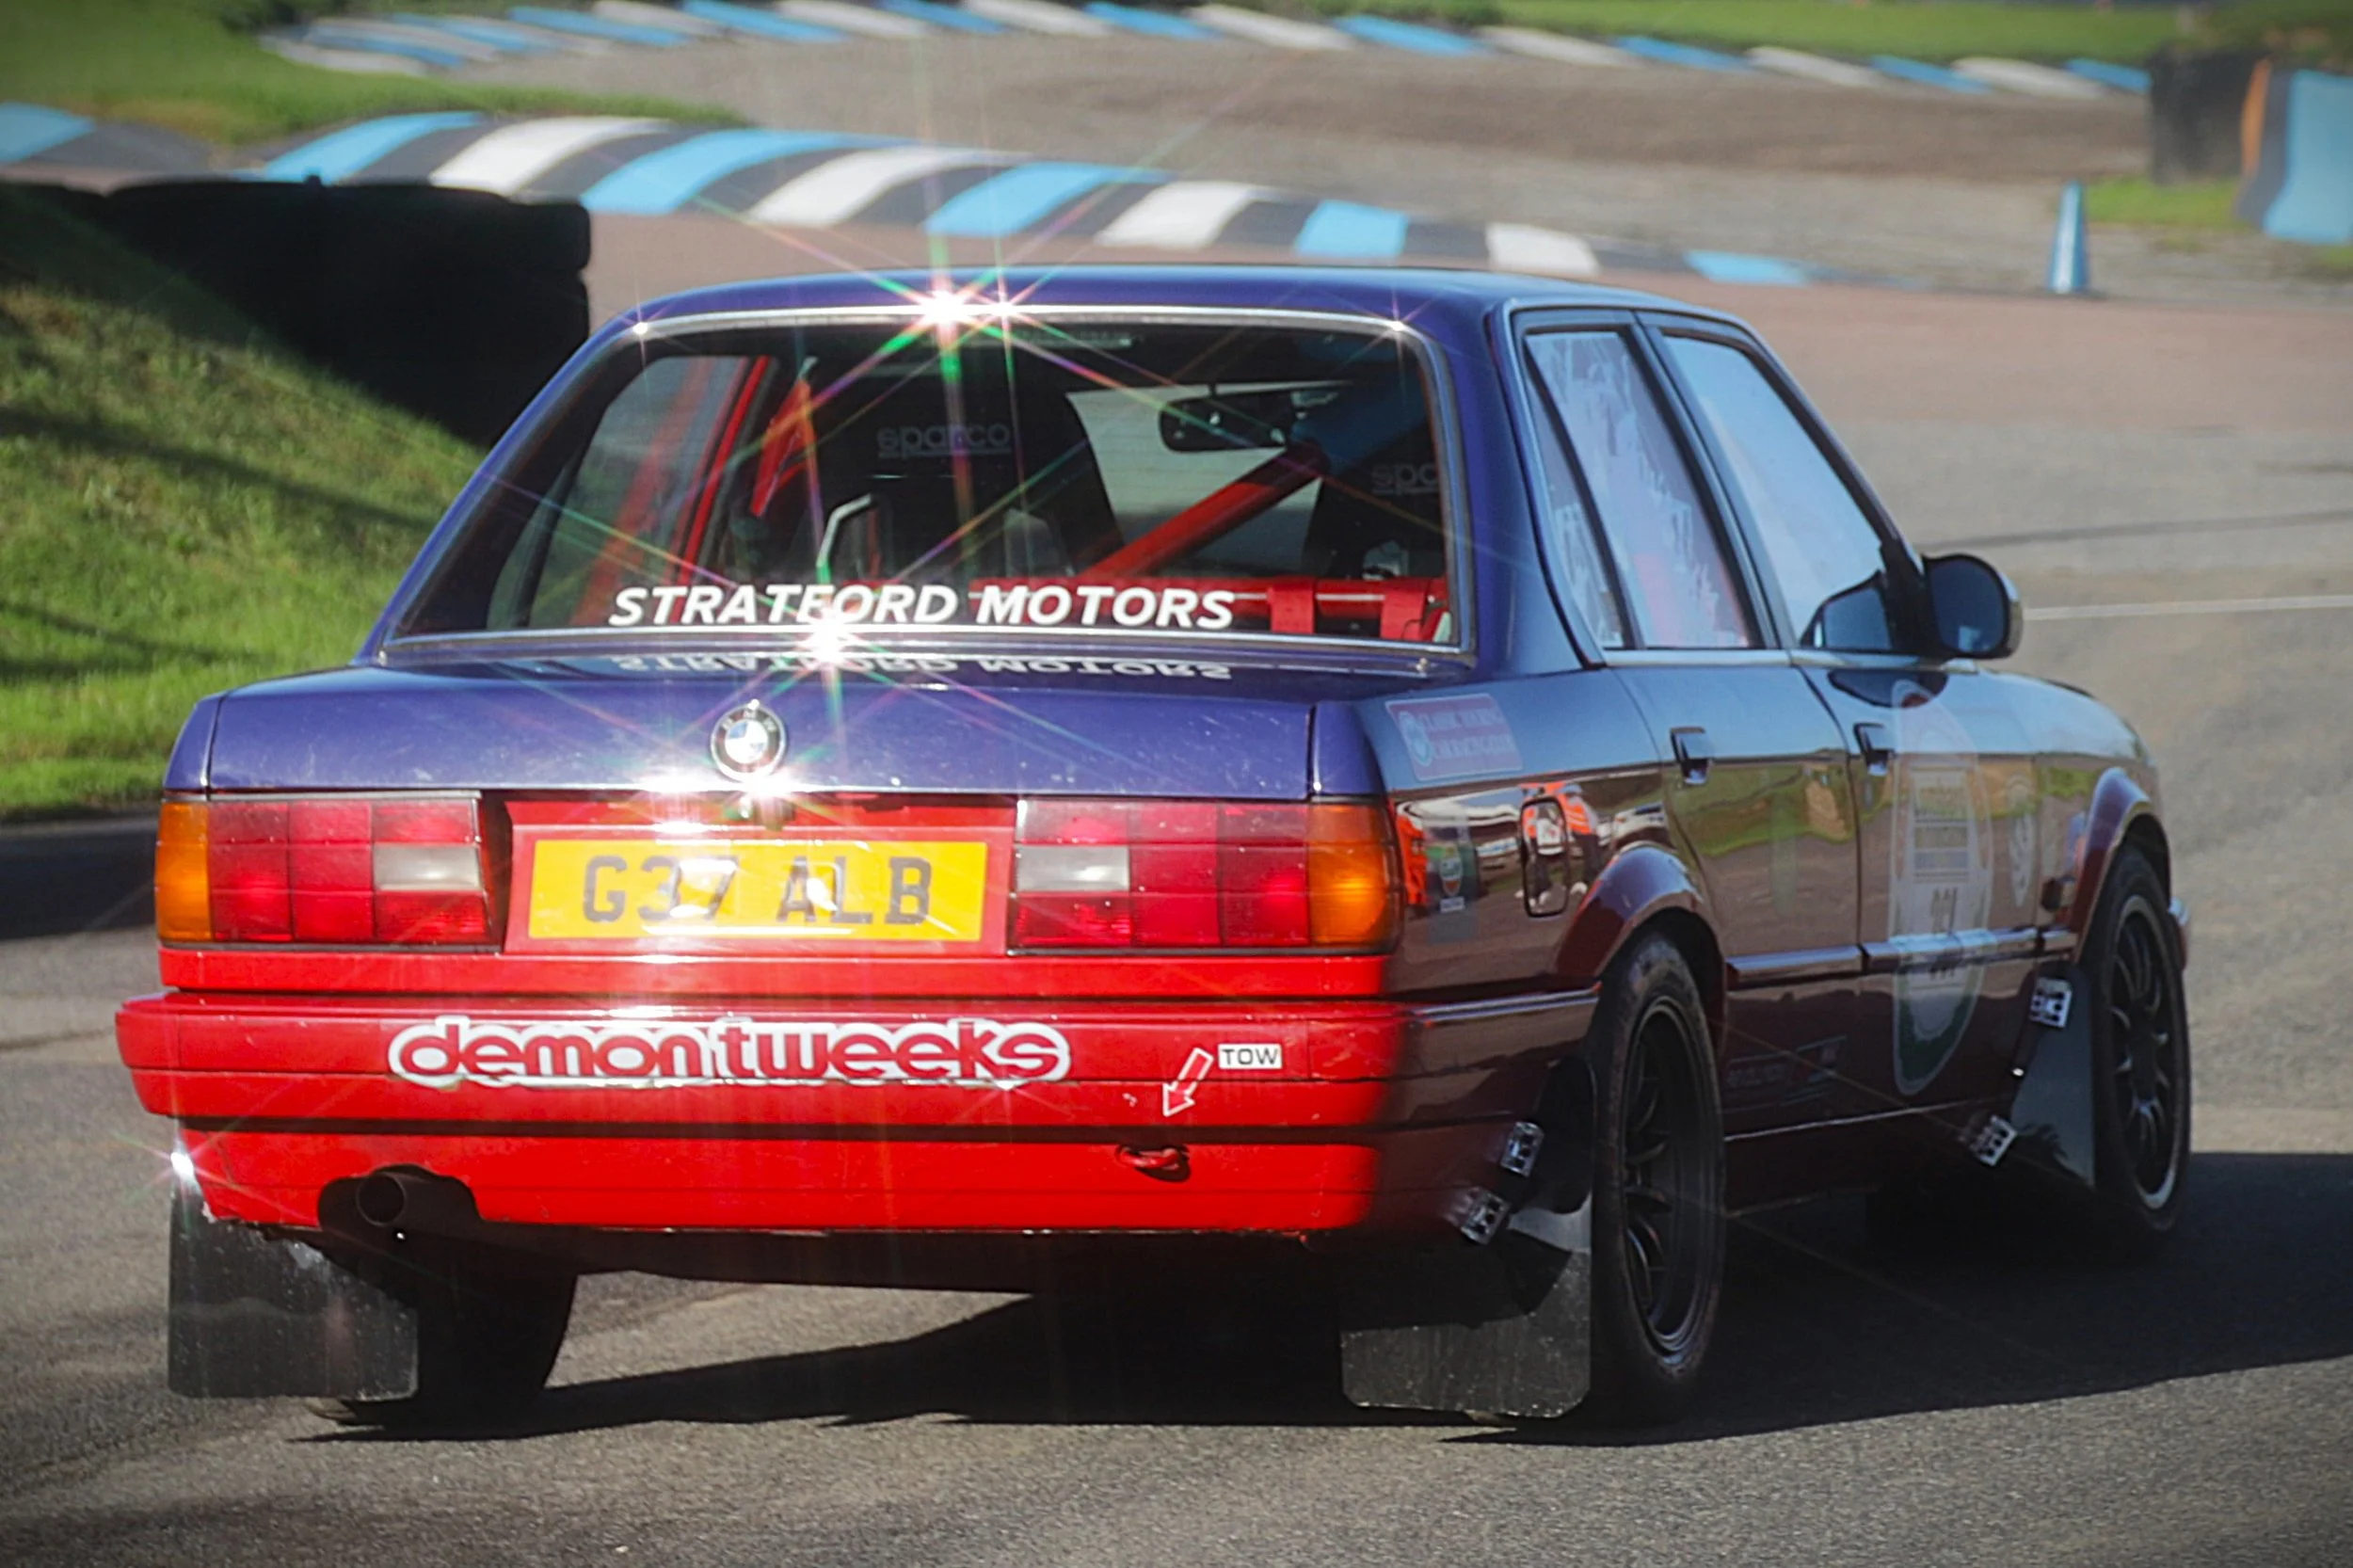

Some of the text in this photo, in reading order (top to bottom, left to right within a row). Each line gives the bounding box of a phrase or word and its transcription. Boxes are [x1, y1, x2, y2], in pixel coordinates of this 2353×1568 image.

[877, 424, 1011, 460] sparco
[1371, 463, 1438, 498] spa
[609, 584, 1235, 629] STRATFORD MOTORS
[582, 855, 933, 926] G37 ALB
[1221, 1048, 1278, 1065] TOW
